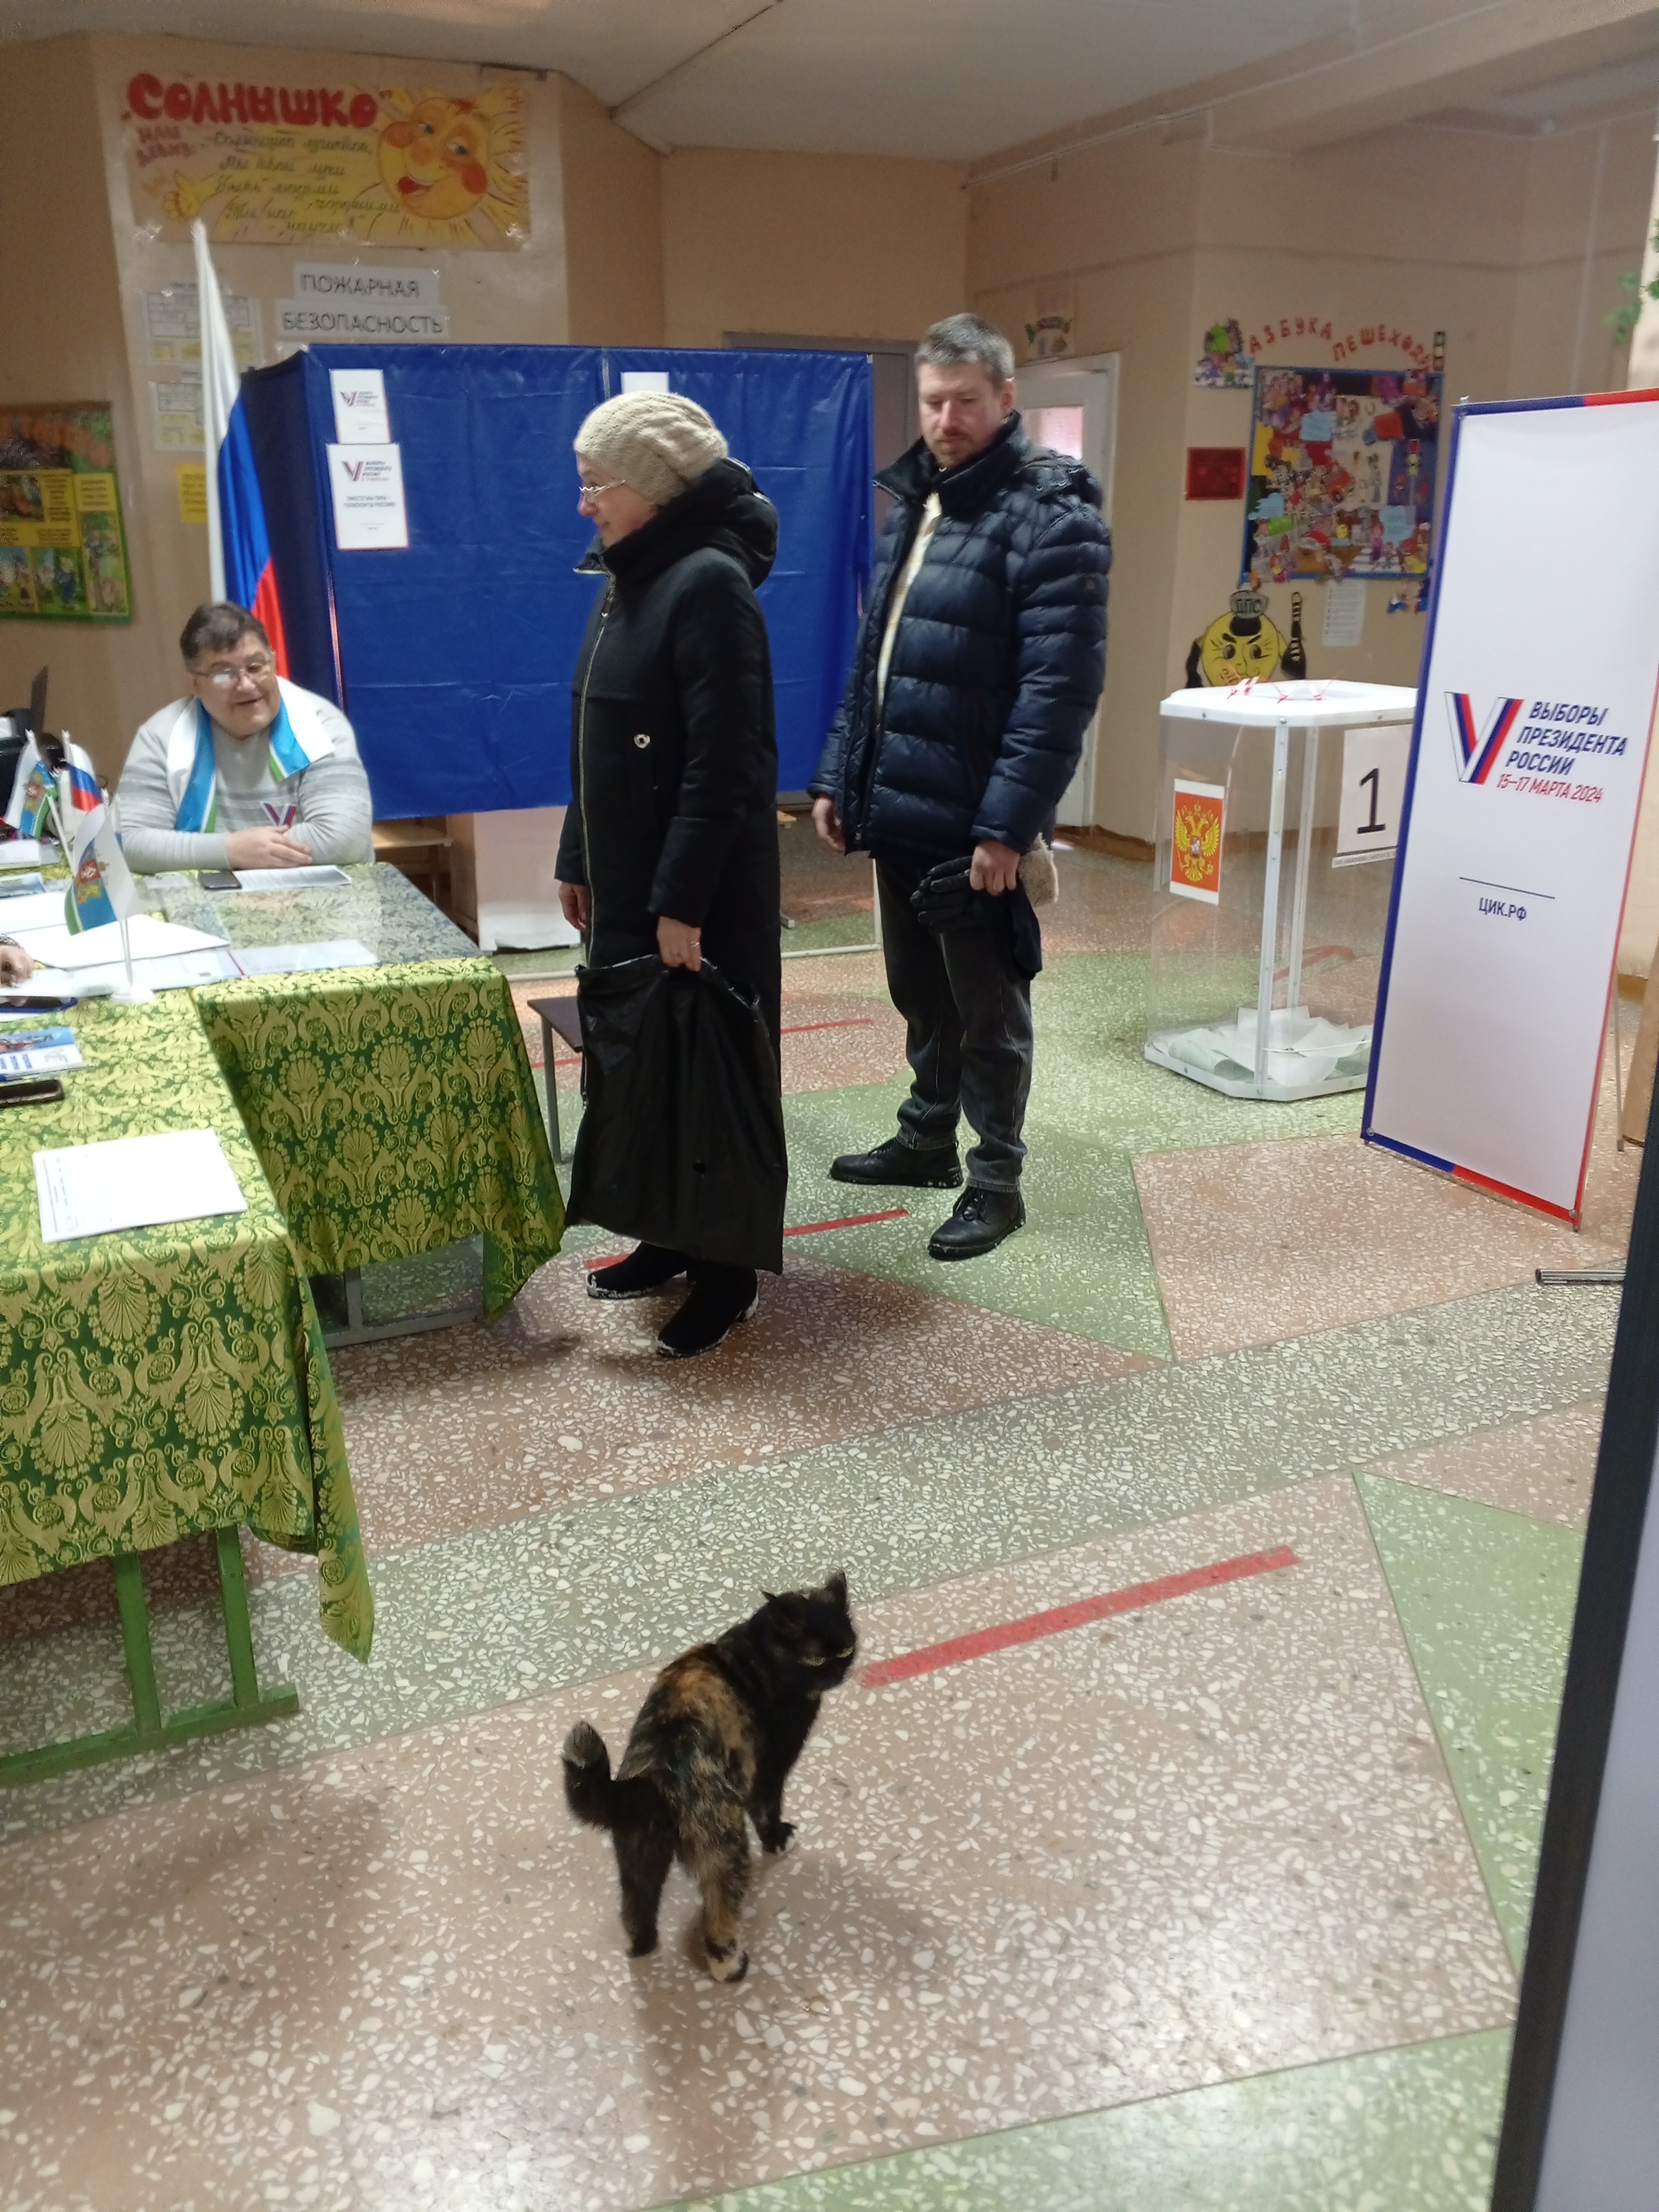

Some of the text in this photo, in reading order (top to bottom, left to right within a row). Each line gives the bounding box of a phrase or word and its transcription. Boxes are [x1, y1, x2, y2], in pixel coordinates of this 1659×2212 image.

[301, 273, 420, 298] ПОЖАРНАЯ
[282, 311, 443, 334] БЕЗОПАСНОСТЬ
[1249, 316, 1332, 355] АЗБУКА
[1528, 701, 1609, 727] ВЫБОРЫ
[1517, 726, 1629, 757] ПРЕЗИДЕНТА
[1506, 750, 1576, 776] РОССИИ
[1356, 767, 1386, 834] 1
[1531, 780, 1571, 800] МАРТА
[1571, 785, 1604, 803] 2024
[1478, 897, 1527, 921] ЦИК.РФ
